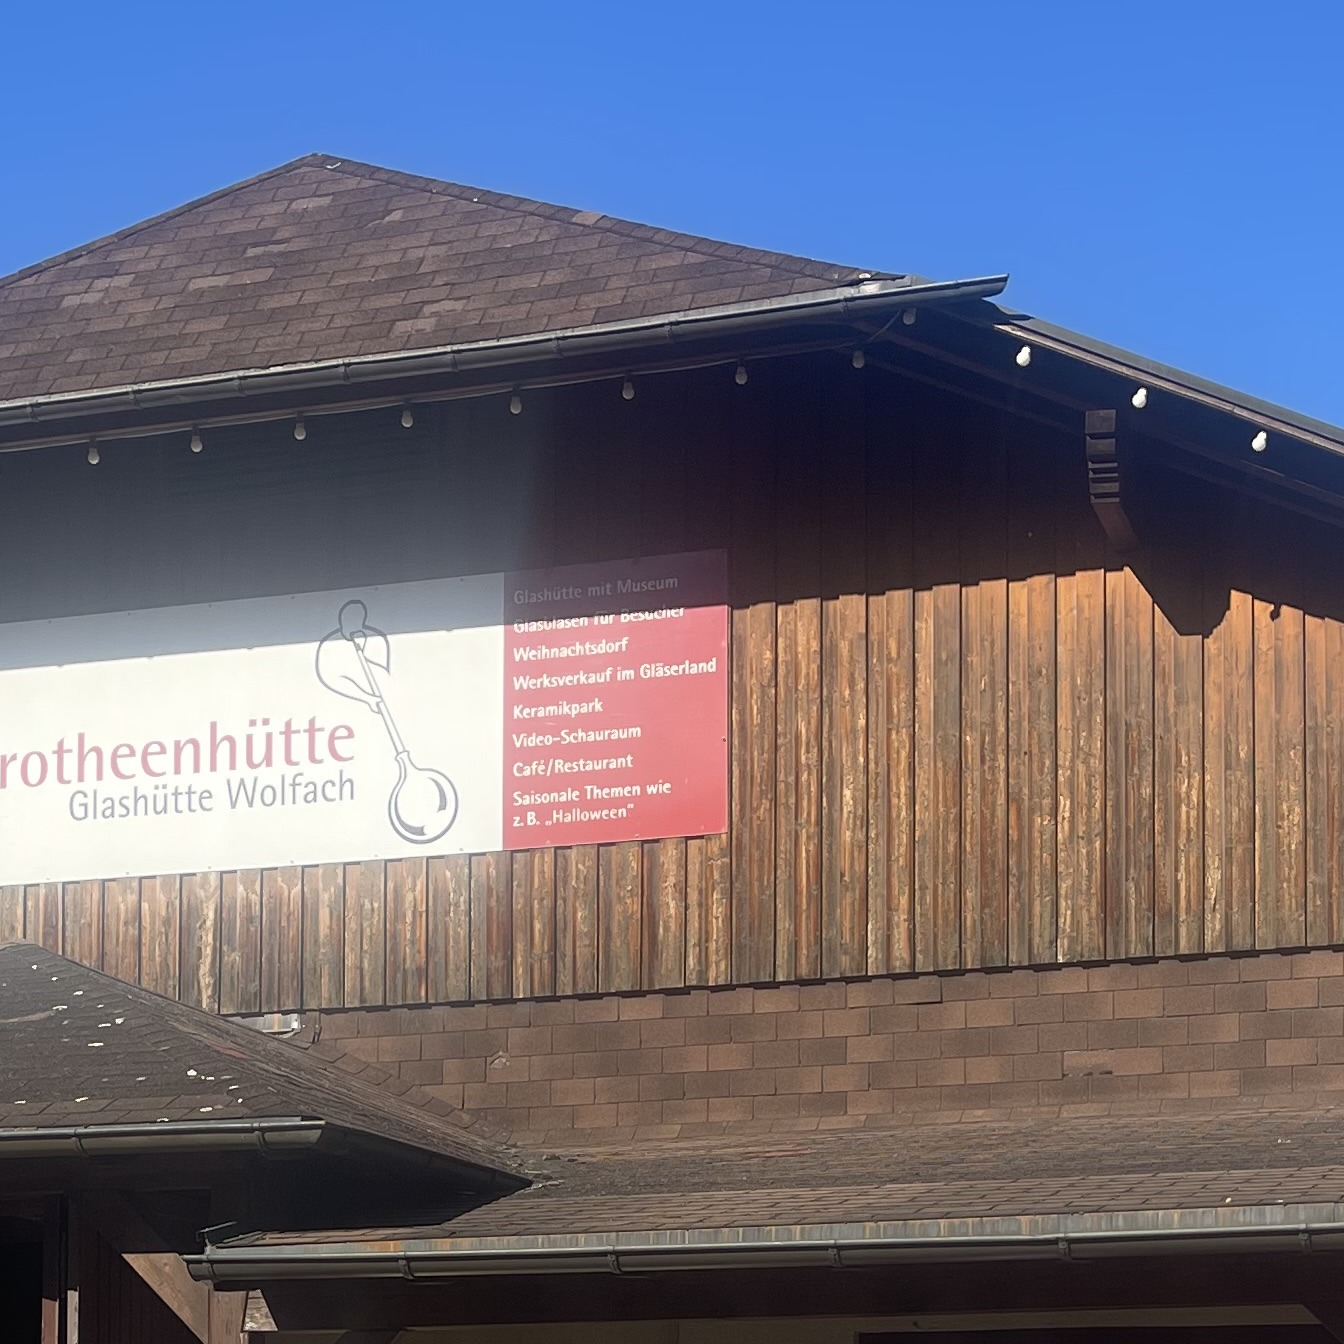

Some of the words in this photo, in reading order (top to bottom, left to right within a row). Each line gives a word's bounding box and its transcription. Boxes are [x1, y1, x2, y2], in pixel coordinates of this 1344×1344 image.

[514, 585, 582, 605] Glashütte
[588, 582, 611, 597] mit
[617, 576, 678, 593] Museum
[513, 637, 629, 662] Weihnachtsdorf
[513, 667, 612, 691] Werksverkauf
[617, 667, 634, 682] im
[639, 657, 717, 680] Gläserland
[513, 698, 603, 720] Keramikpark
[512, 726, 641, 748] Video-Schauraum
[513, 754, 633, 778] Café/Restaurant
[68, 783, 214, 821] Glashütte
[227, 770, 355, 811] Wolfach
[513, 789, 580, 806] Saisonale
[584, 784, 640, 801] Themen
[646, 779, 672, 795] wie
